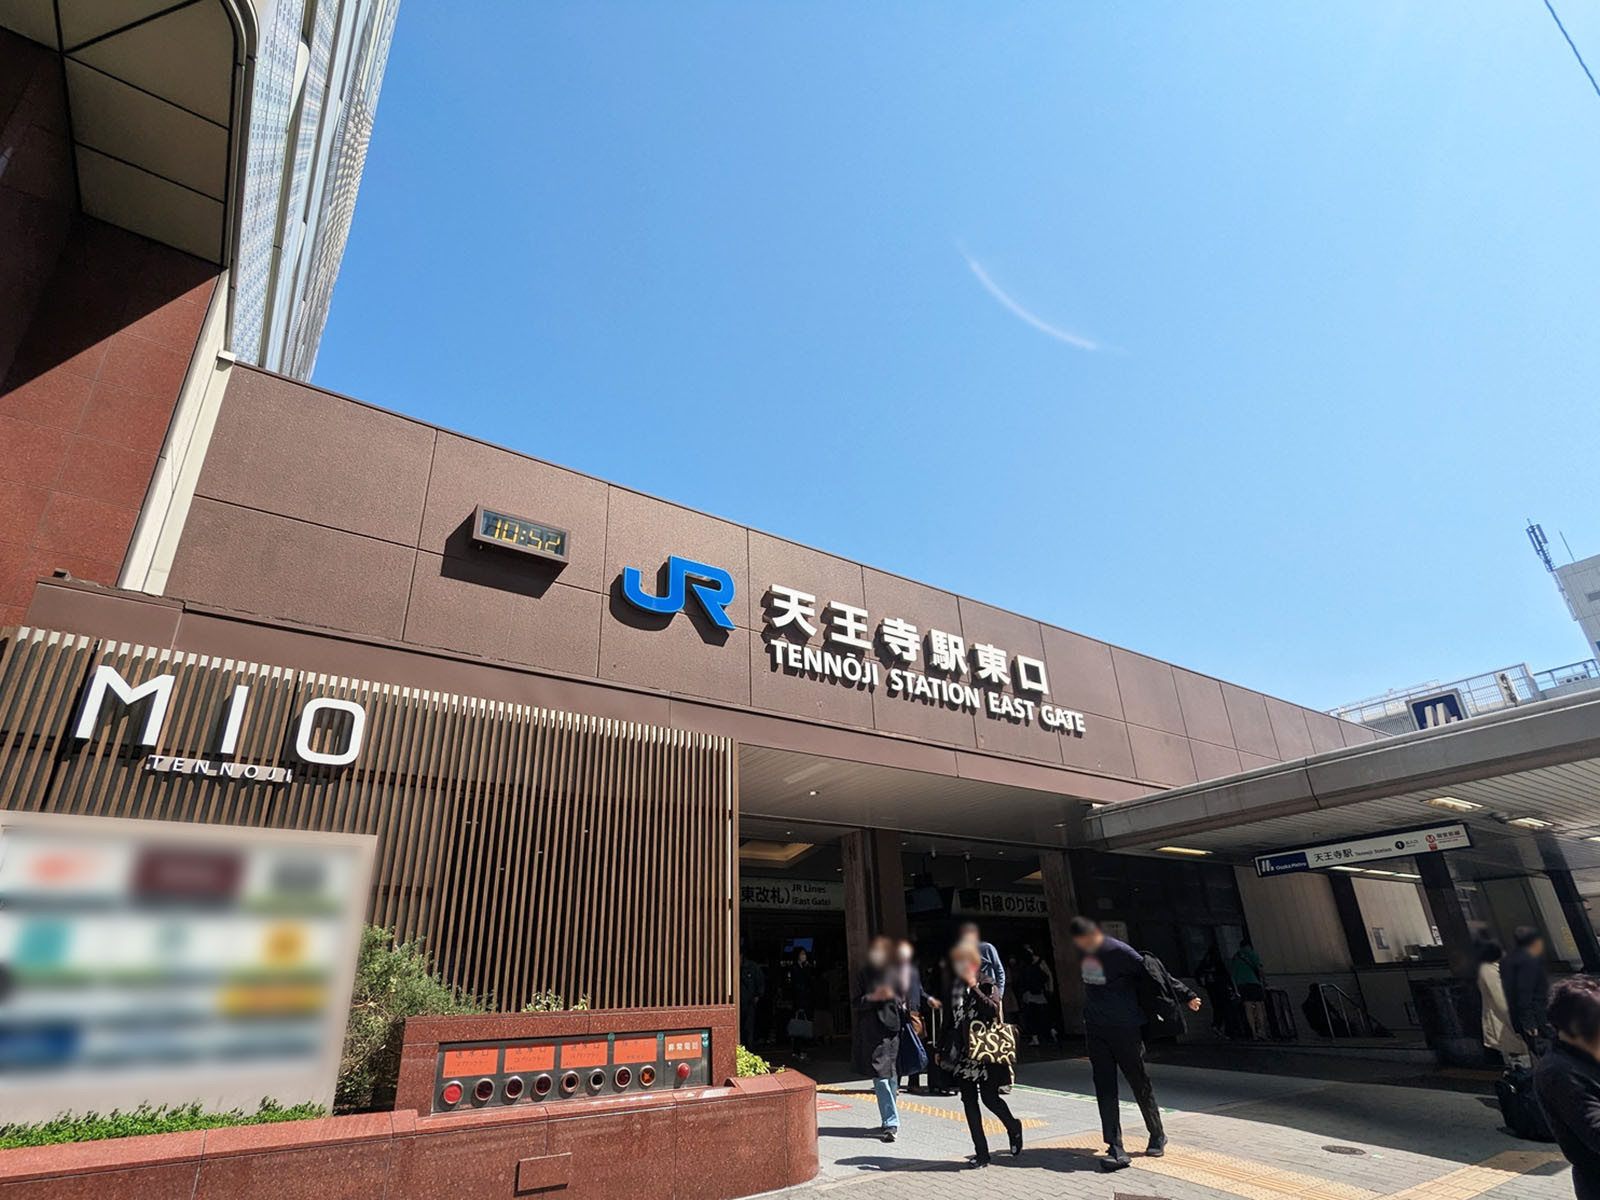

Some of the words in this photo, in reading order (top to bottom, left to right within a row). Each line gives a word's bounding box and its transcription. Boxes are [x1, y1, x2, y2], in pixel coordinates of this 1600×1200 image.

[494, 519, 561, 552] 10:52
[623, 555, 736, 630] JR
[769, 584, 1050, 695] 天王寺駅東口
[75, 665, 367, 767] MIO
[890, 668, 981, 708] STATION
[988, 691, 1035, 721] EAST
[1041, 705, 1087, 733] GATE
[149, 754, 293, 783] TENNOJI
[1313, 848, 1354, 862] 天王寺駅
[791, 884, 802, 893] JR
[803, 885, 825, 894] Lines
